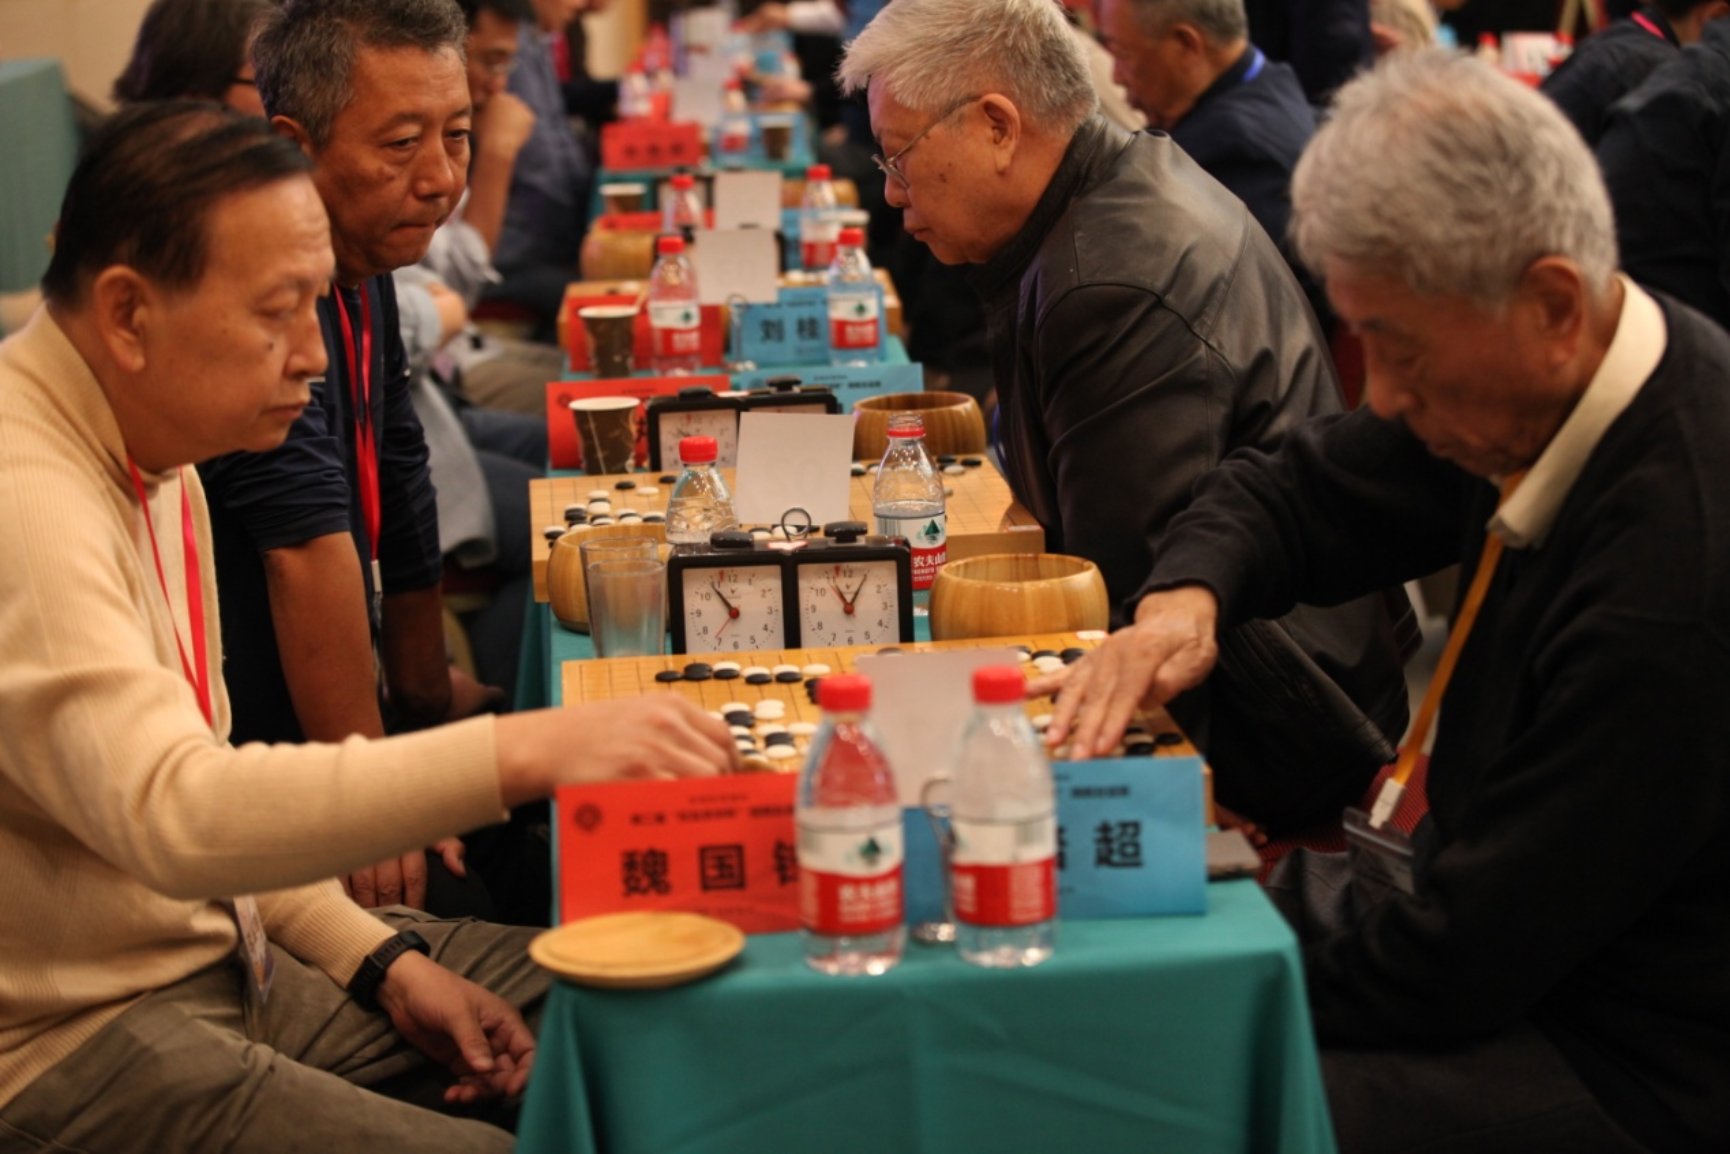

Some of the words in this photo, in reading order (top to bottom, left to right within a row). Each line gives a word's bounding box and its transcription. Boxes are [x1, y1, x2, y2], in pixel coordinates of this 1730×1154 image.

[843, 568, 854, 578] 12
[728, 574, 738, 583] 12
[701, 592, 711, 601] 10
[815, 587, 826, 597] 10
[702, 625, 709, 635] 8
[817, 621, 823, 631] 8
[1056, 820, 1144, 870] 超
